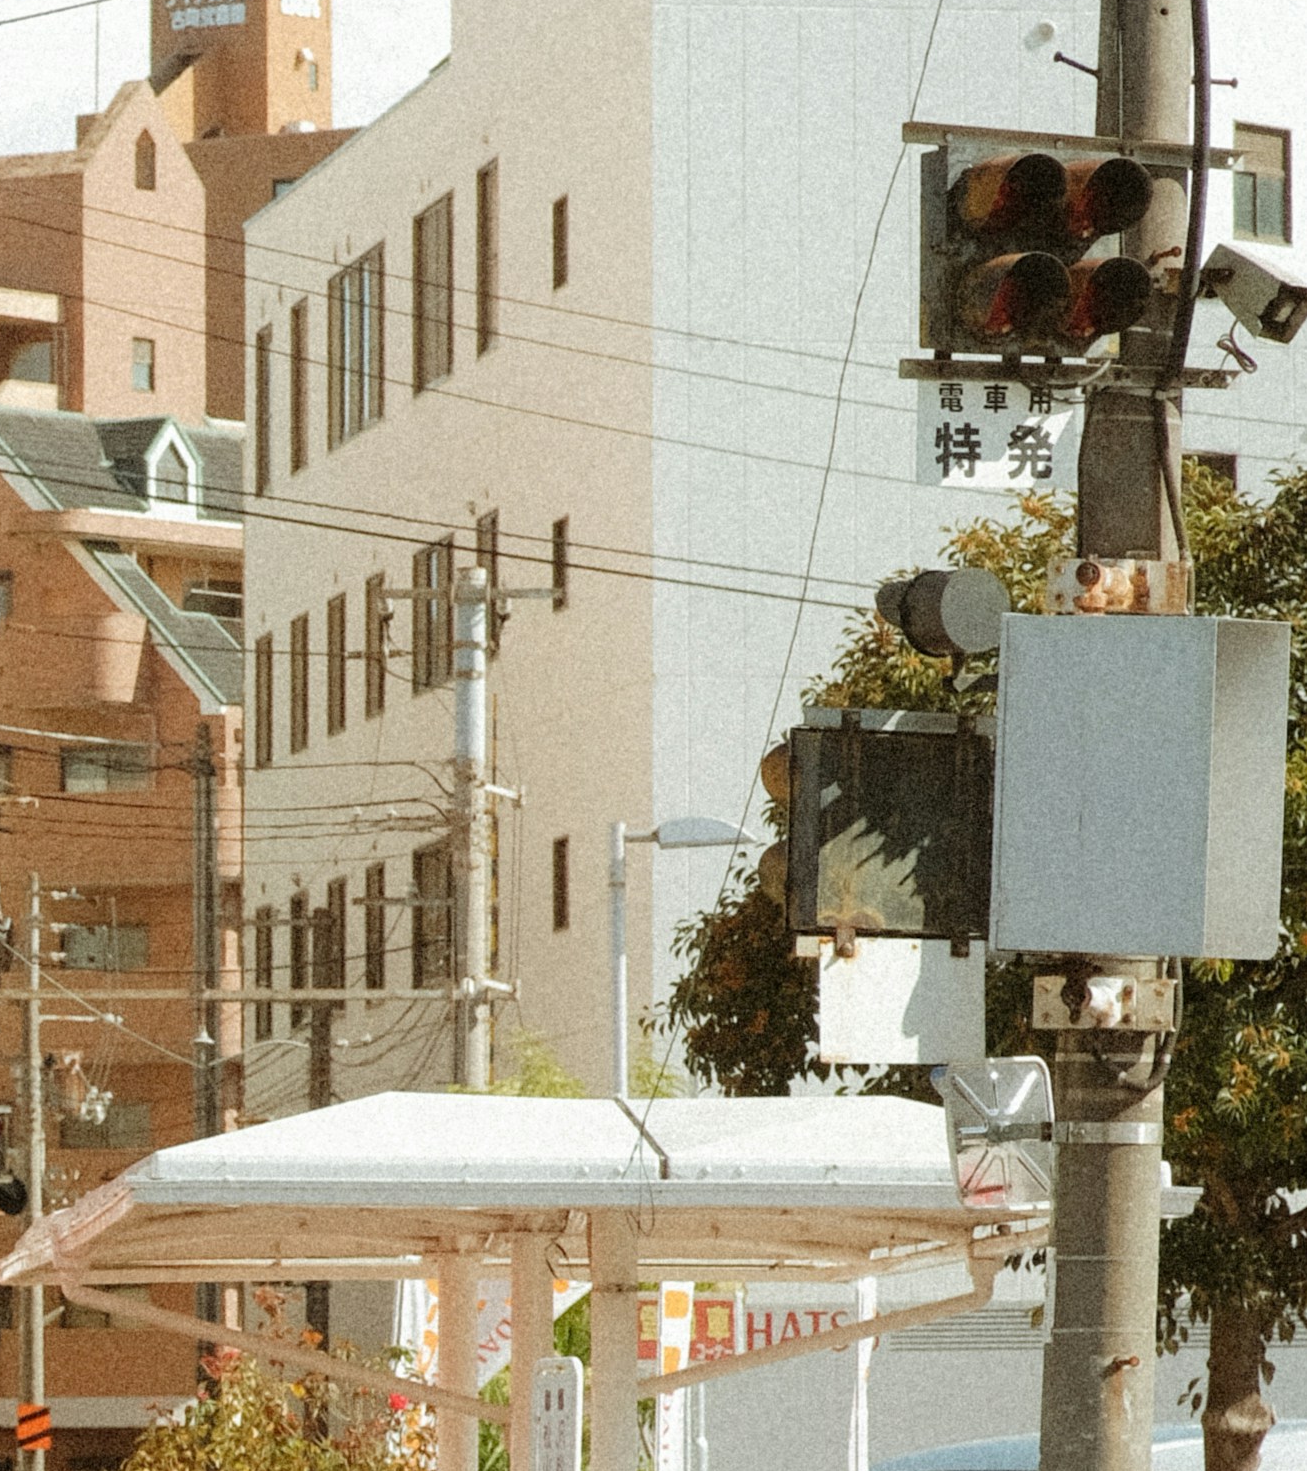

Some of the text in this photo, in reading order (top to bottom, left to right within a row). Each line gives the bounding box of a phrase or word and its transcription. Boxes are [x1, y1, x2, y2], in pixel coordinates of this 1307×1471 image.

[939, 383, 1052, 414] 電車用
[935, 422, 1054, 479] 特発
[747, 1309, 879, 1353] HATS
